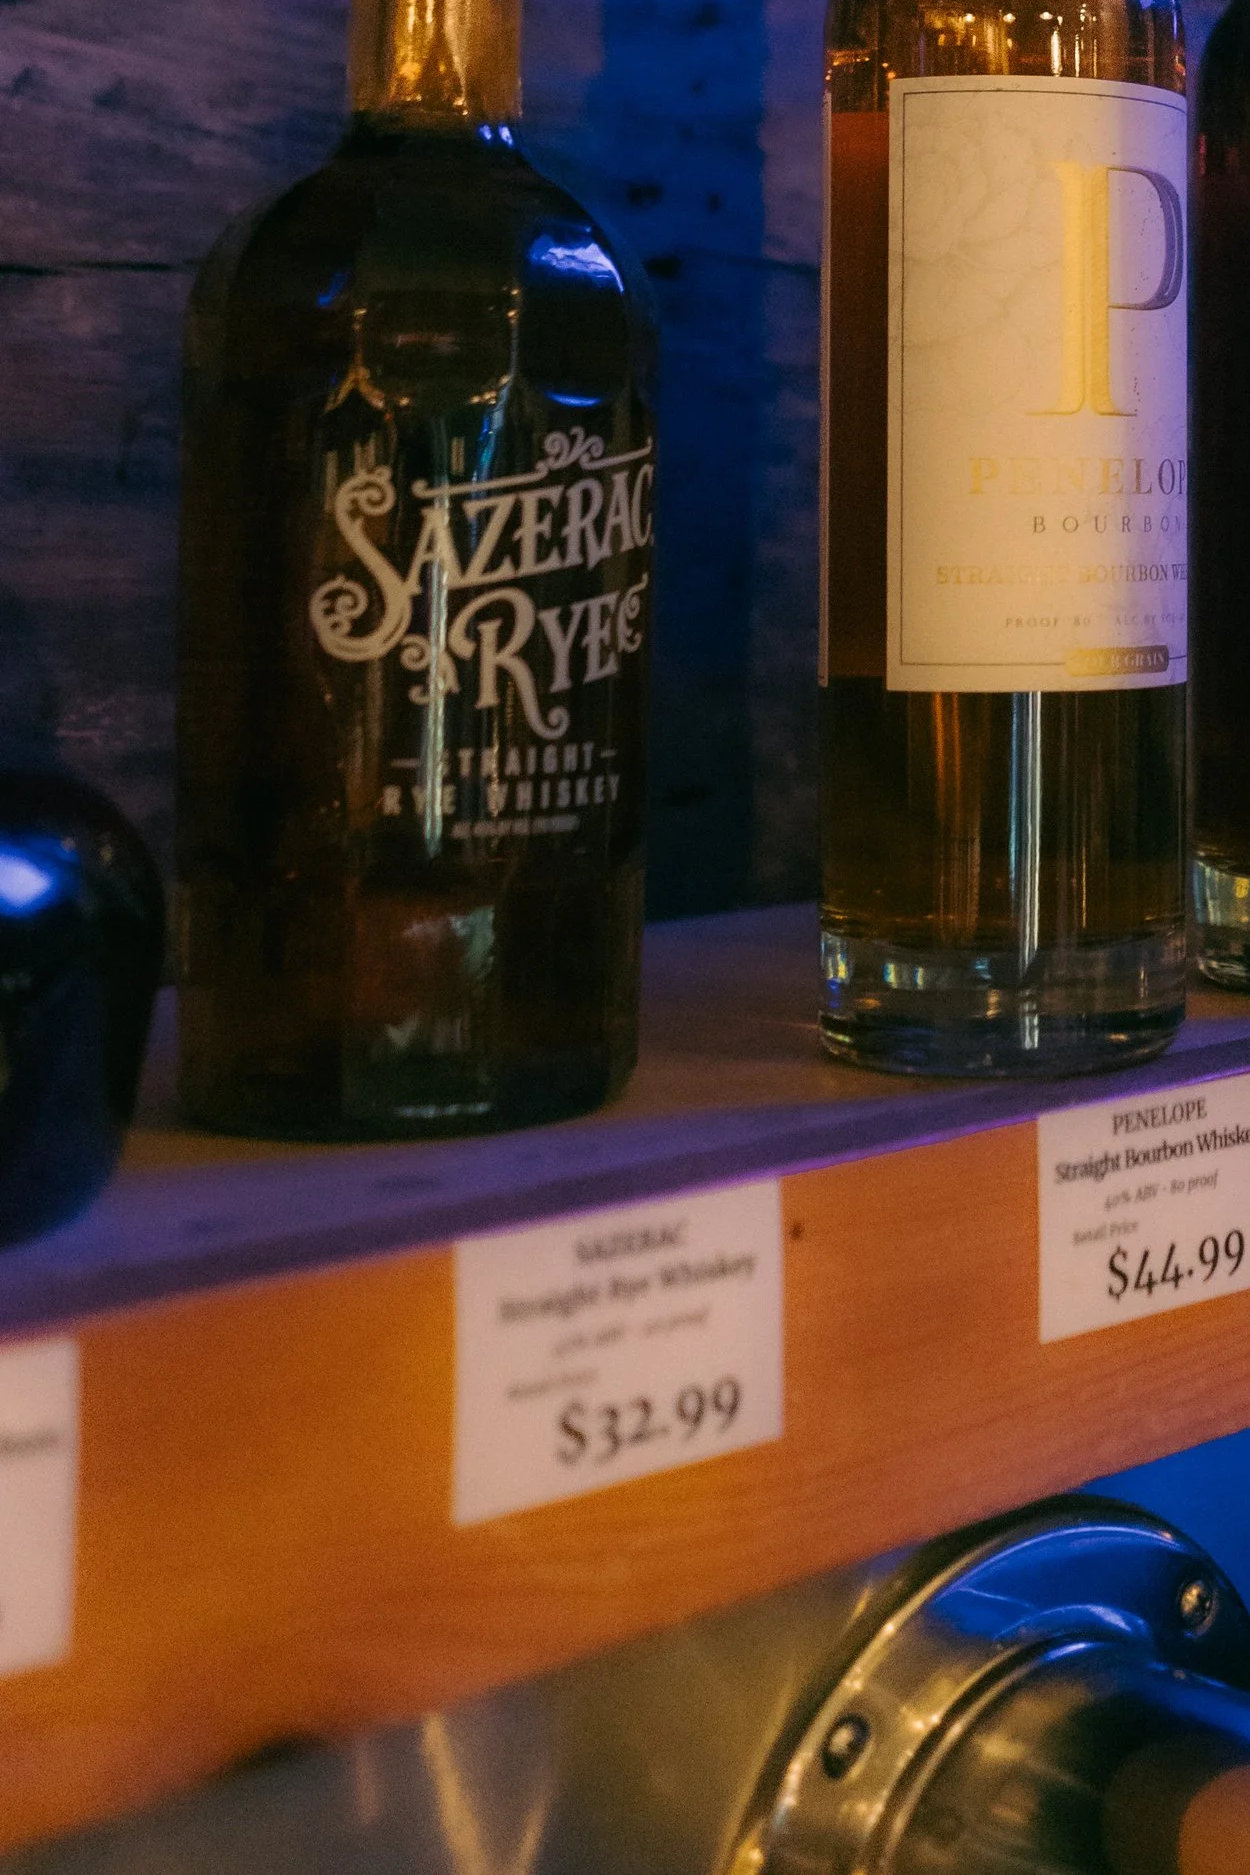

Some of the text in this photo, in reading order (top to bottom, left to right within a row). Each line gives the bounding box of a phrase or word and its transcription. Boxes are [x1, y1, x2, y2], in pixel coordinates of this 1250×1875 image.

[1032, 515, 1183, 534] BOURBON
[309, 463, 655, 661] SAZERAC
[1078, 563, 1168, 584] BOURBON
[447, 572, 648, 739] RYE
[1112, 1097, 1207, 1136] PENELOPE
[1055, 1151, 1121, 1184] Straight
[1125, 1139, 1194, 1170] Bourbon
[1187, 1169, 1218, 1197] proof
[1108, 1228, 1245, 1303] $44.99
[556, 1375, 742, 1467] $32.99
